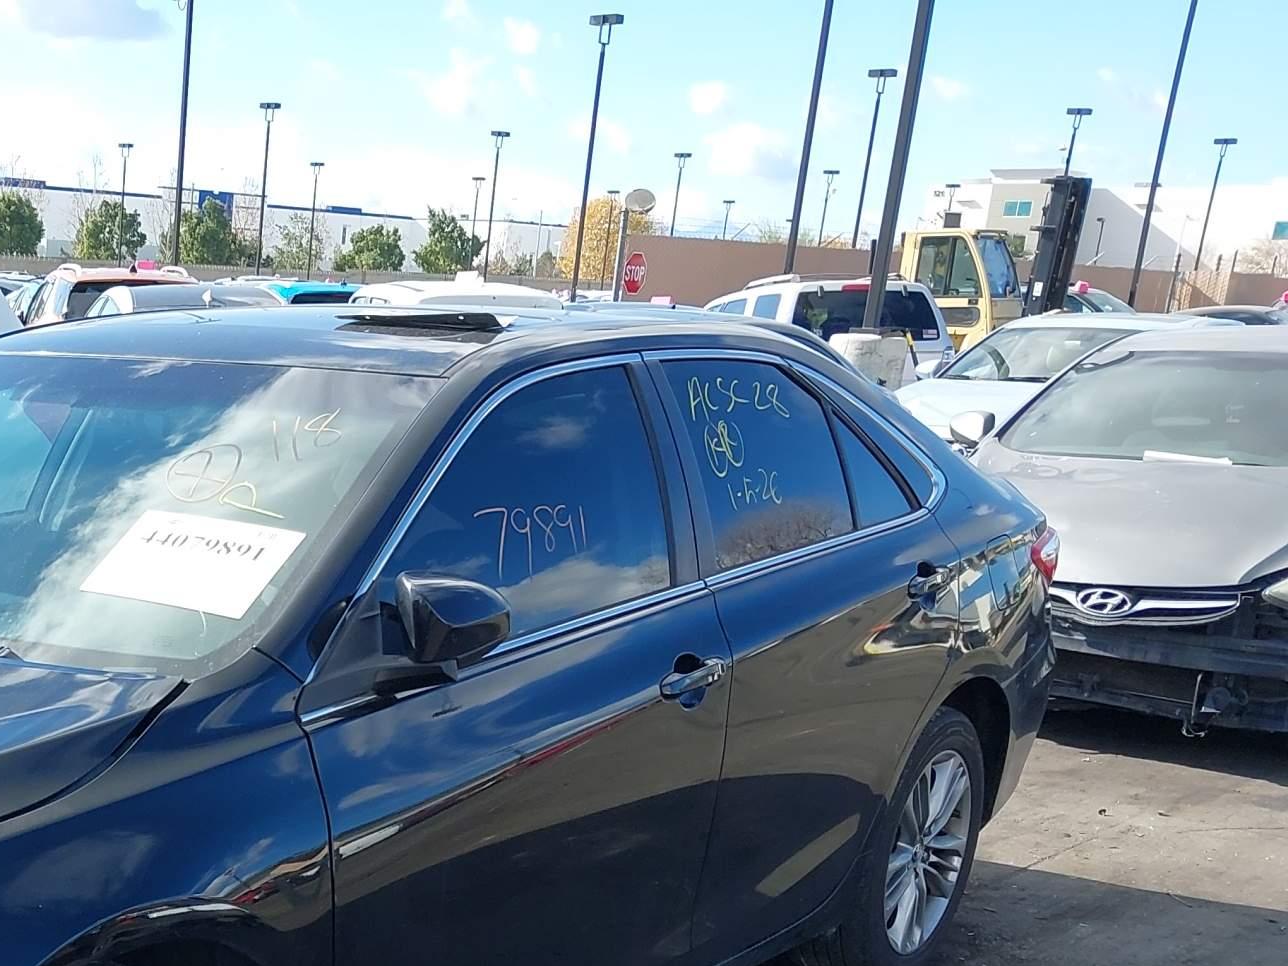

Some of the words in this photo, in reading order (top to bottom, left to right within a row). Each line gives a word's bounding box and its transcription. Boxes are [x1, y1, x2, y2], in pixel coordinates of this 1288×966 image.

[624, 265, 646, 281] STOP
[272, 407, 343, 462] 118
[473, 503, 588, 582] 79891
